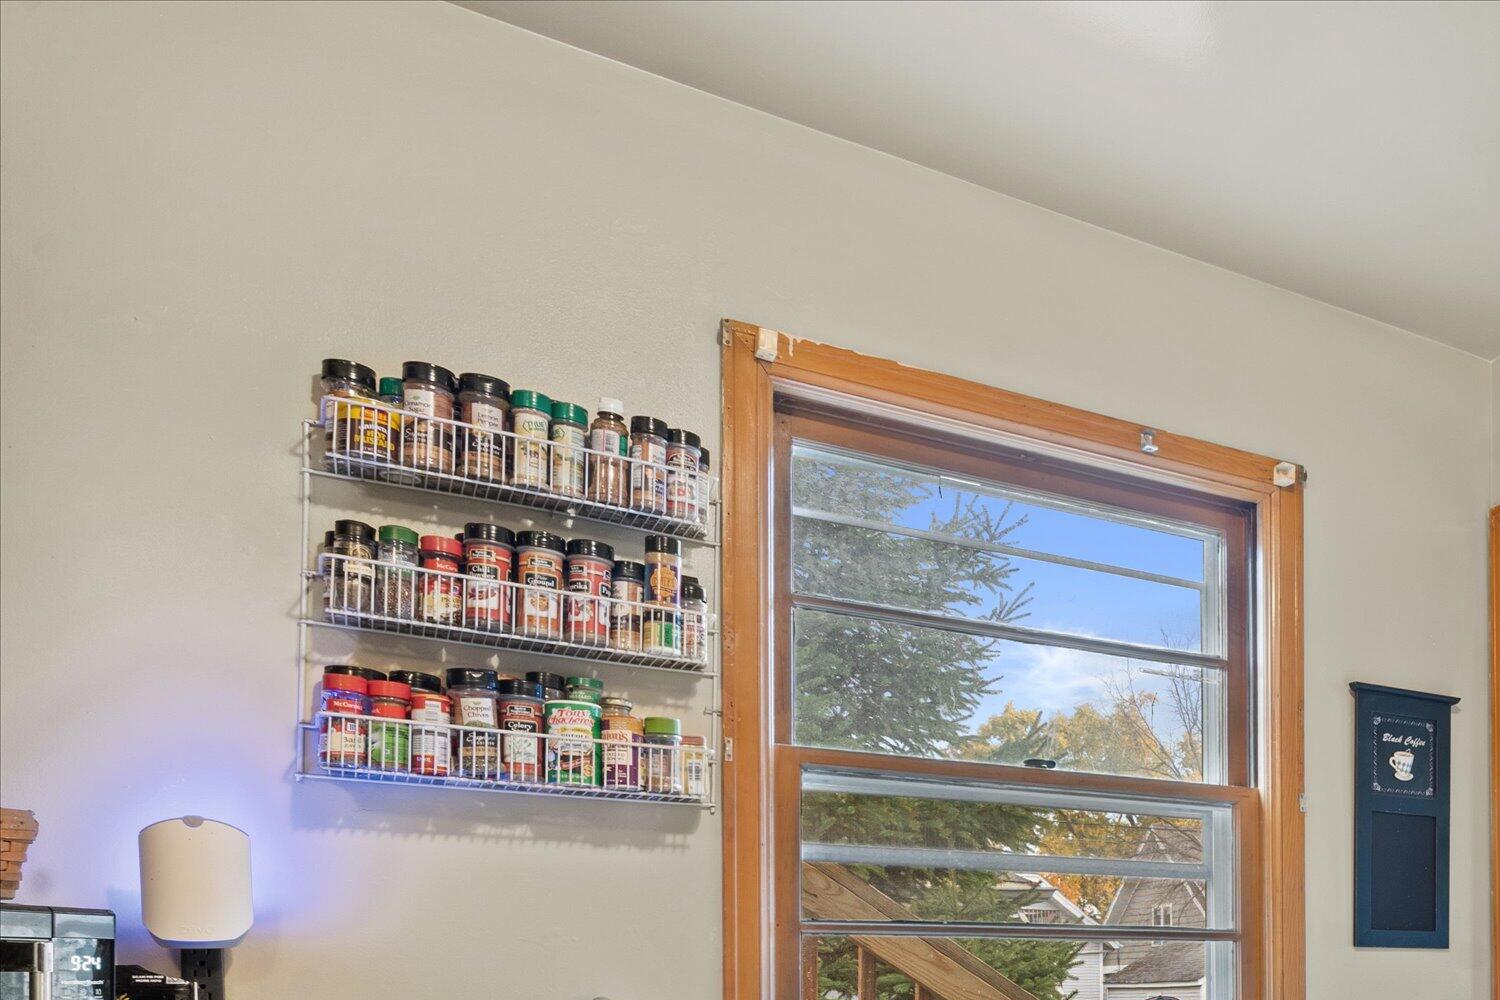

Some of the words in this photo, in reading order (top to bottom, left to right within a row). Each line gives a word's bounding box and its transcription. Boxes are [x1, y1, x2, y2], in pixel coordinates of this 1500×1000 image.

[463, 705, 490, 713] Chopped
[1383, 733, 1402, 742] Black
[1404, 736, 1426, 746] Coffee
